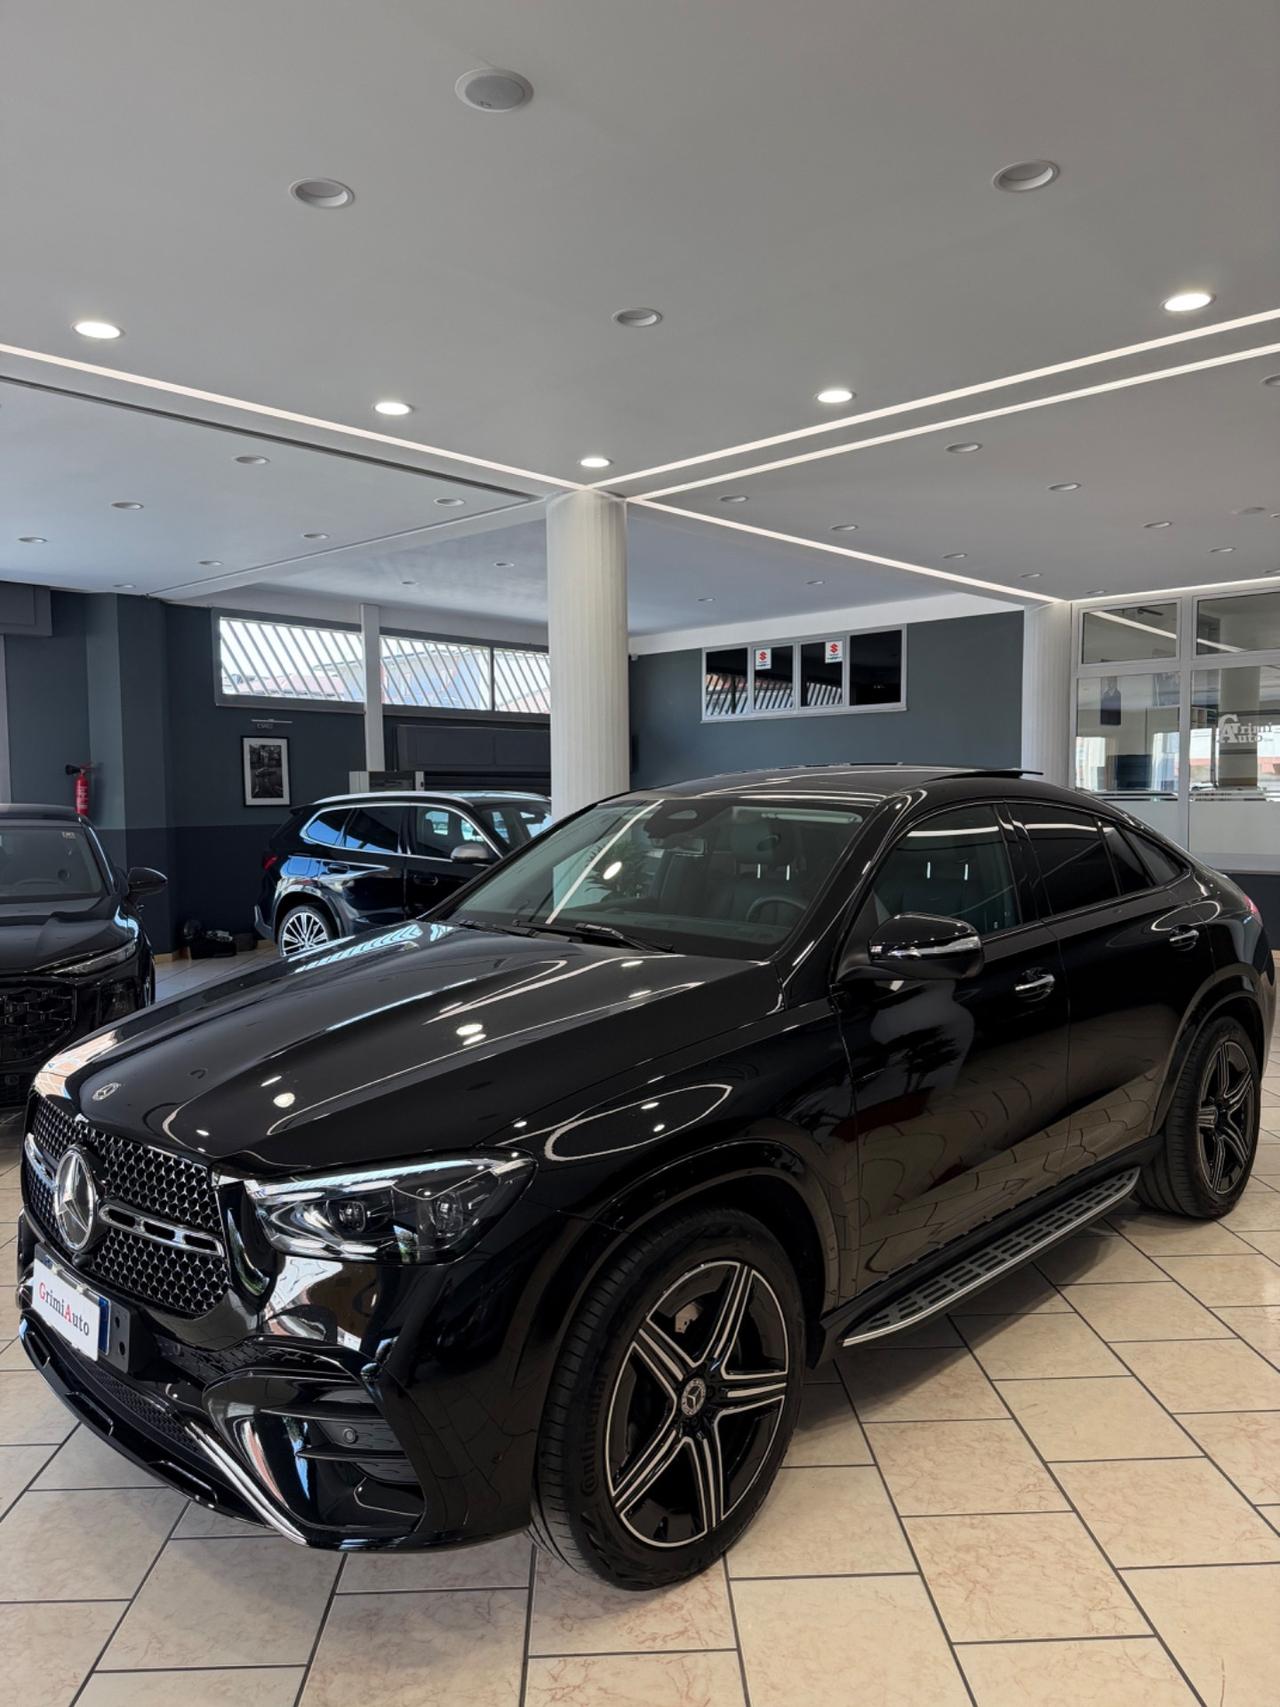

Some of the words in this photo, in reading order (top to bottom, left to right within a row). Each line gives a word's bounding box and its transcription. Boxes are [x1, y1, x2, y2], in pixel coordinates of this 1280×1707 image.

[1218, 723, 1263, 743] Auto
[39, 1282, 90, 1336] GrimiAuto
[580, 1375, 608, 1497] Continental
